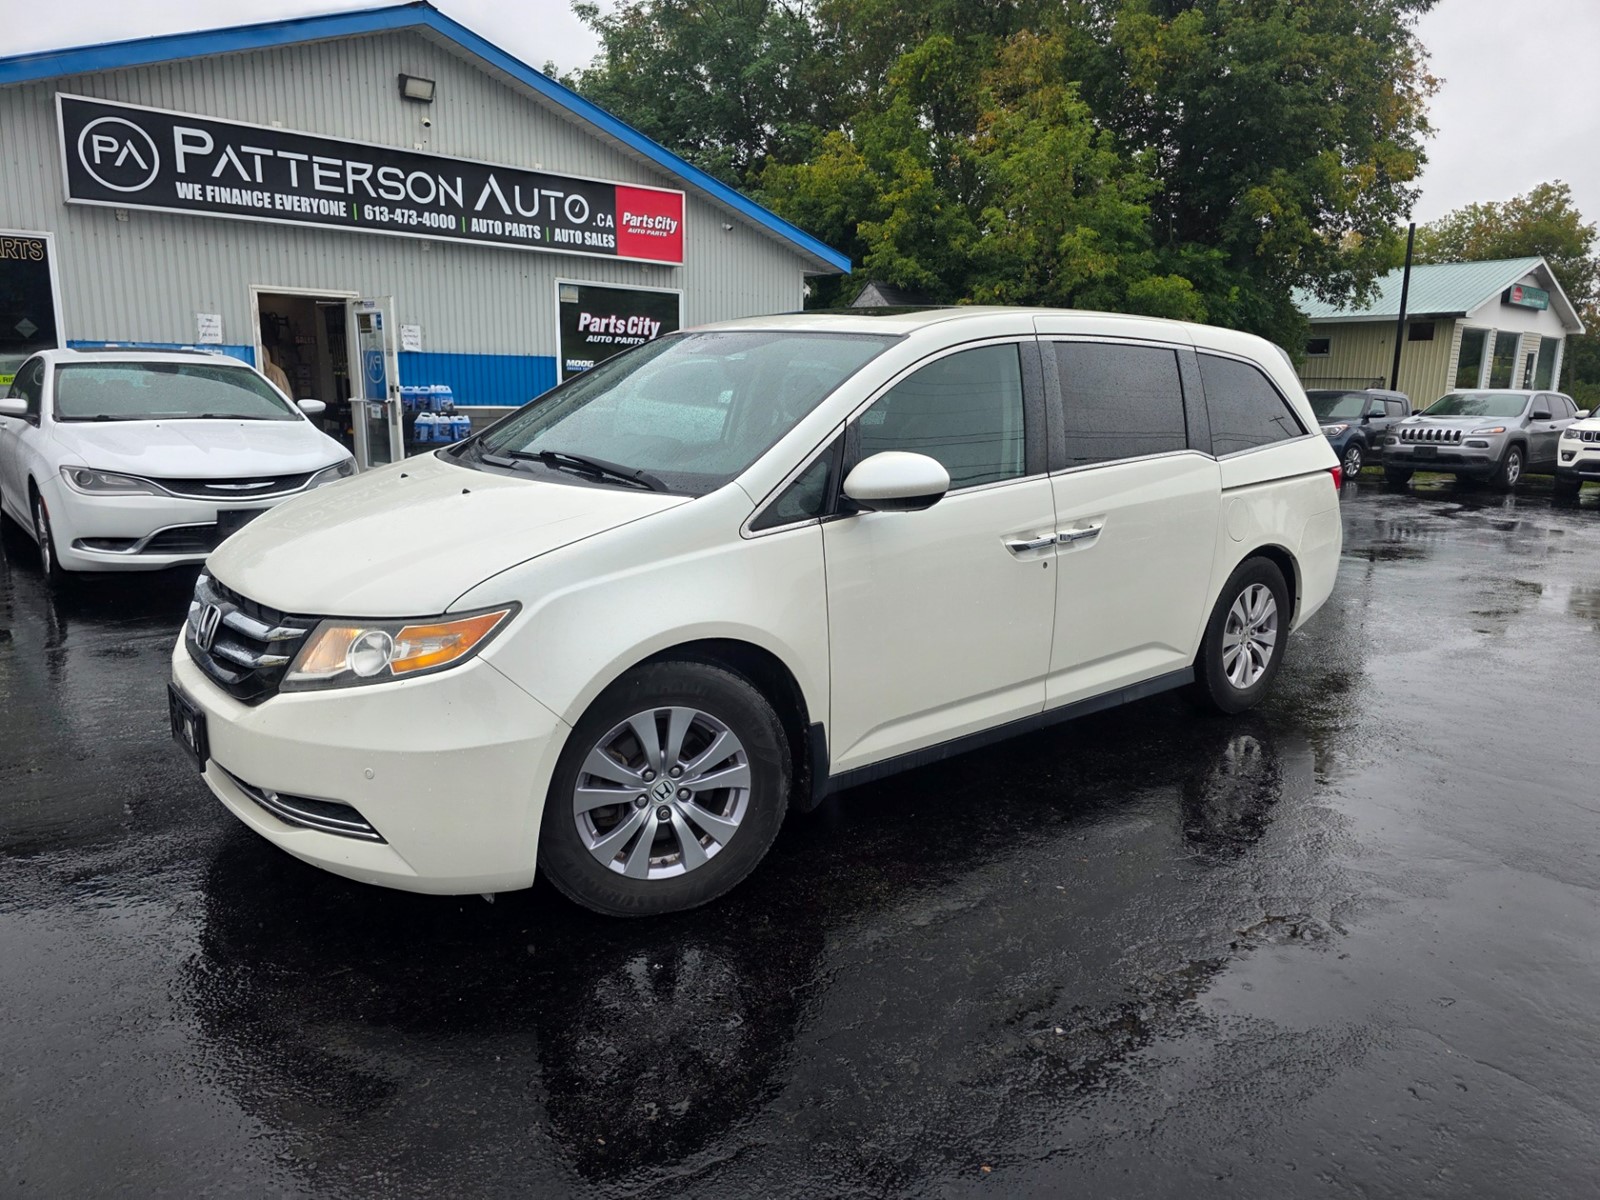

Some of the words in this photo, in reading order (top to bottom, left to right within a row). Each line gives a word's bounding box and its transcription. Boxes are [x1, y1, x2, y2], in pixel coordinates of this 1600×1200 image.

[173, 126, 463, 208] PATTERSON
[474, 173, 590, 224] AUTO
[175, 181, 203, 201] WE
[205, 185, 272, 209] FINANCE
[274, 193, 348, 217] EVERYONE
[364, 204, 456, 230] 613-473-4000
[471, 217, 503, 236] AUTO
[505, 223, 542, 240] PARTS
[554, 228, 583, 245] AUTO
[584, 231, 616, 249] SALES
[627, 228, 645, 236] AUTO
[646, 229, 667, 238] PARTS
[0, 237, 44, 261] RTS
[586, 334, 613, 343] AUTO
[614, 336, 646, 345] PARTS
[566, 359, 594, 367] MOOG
